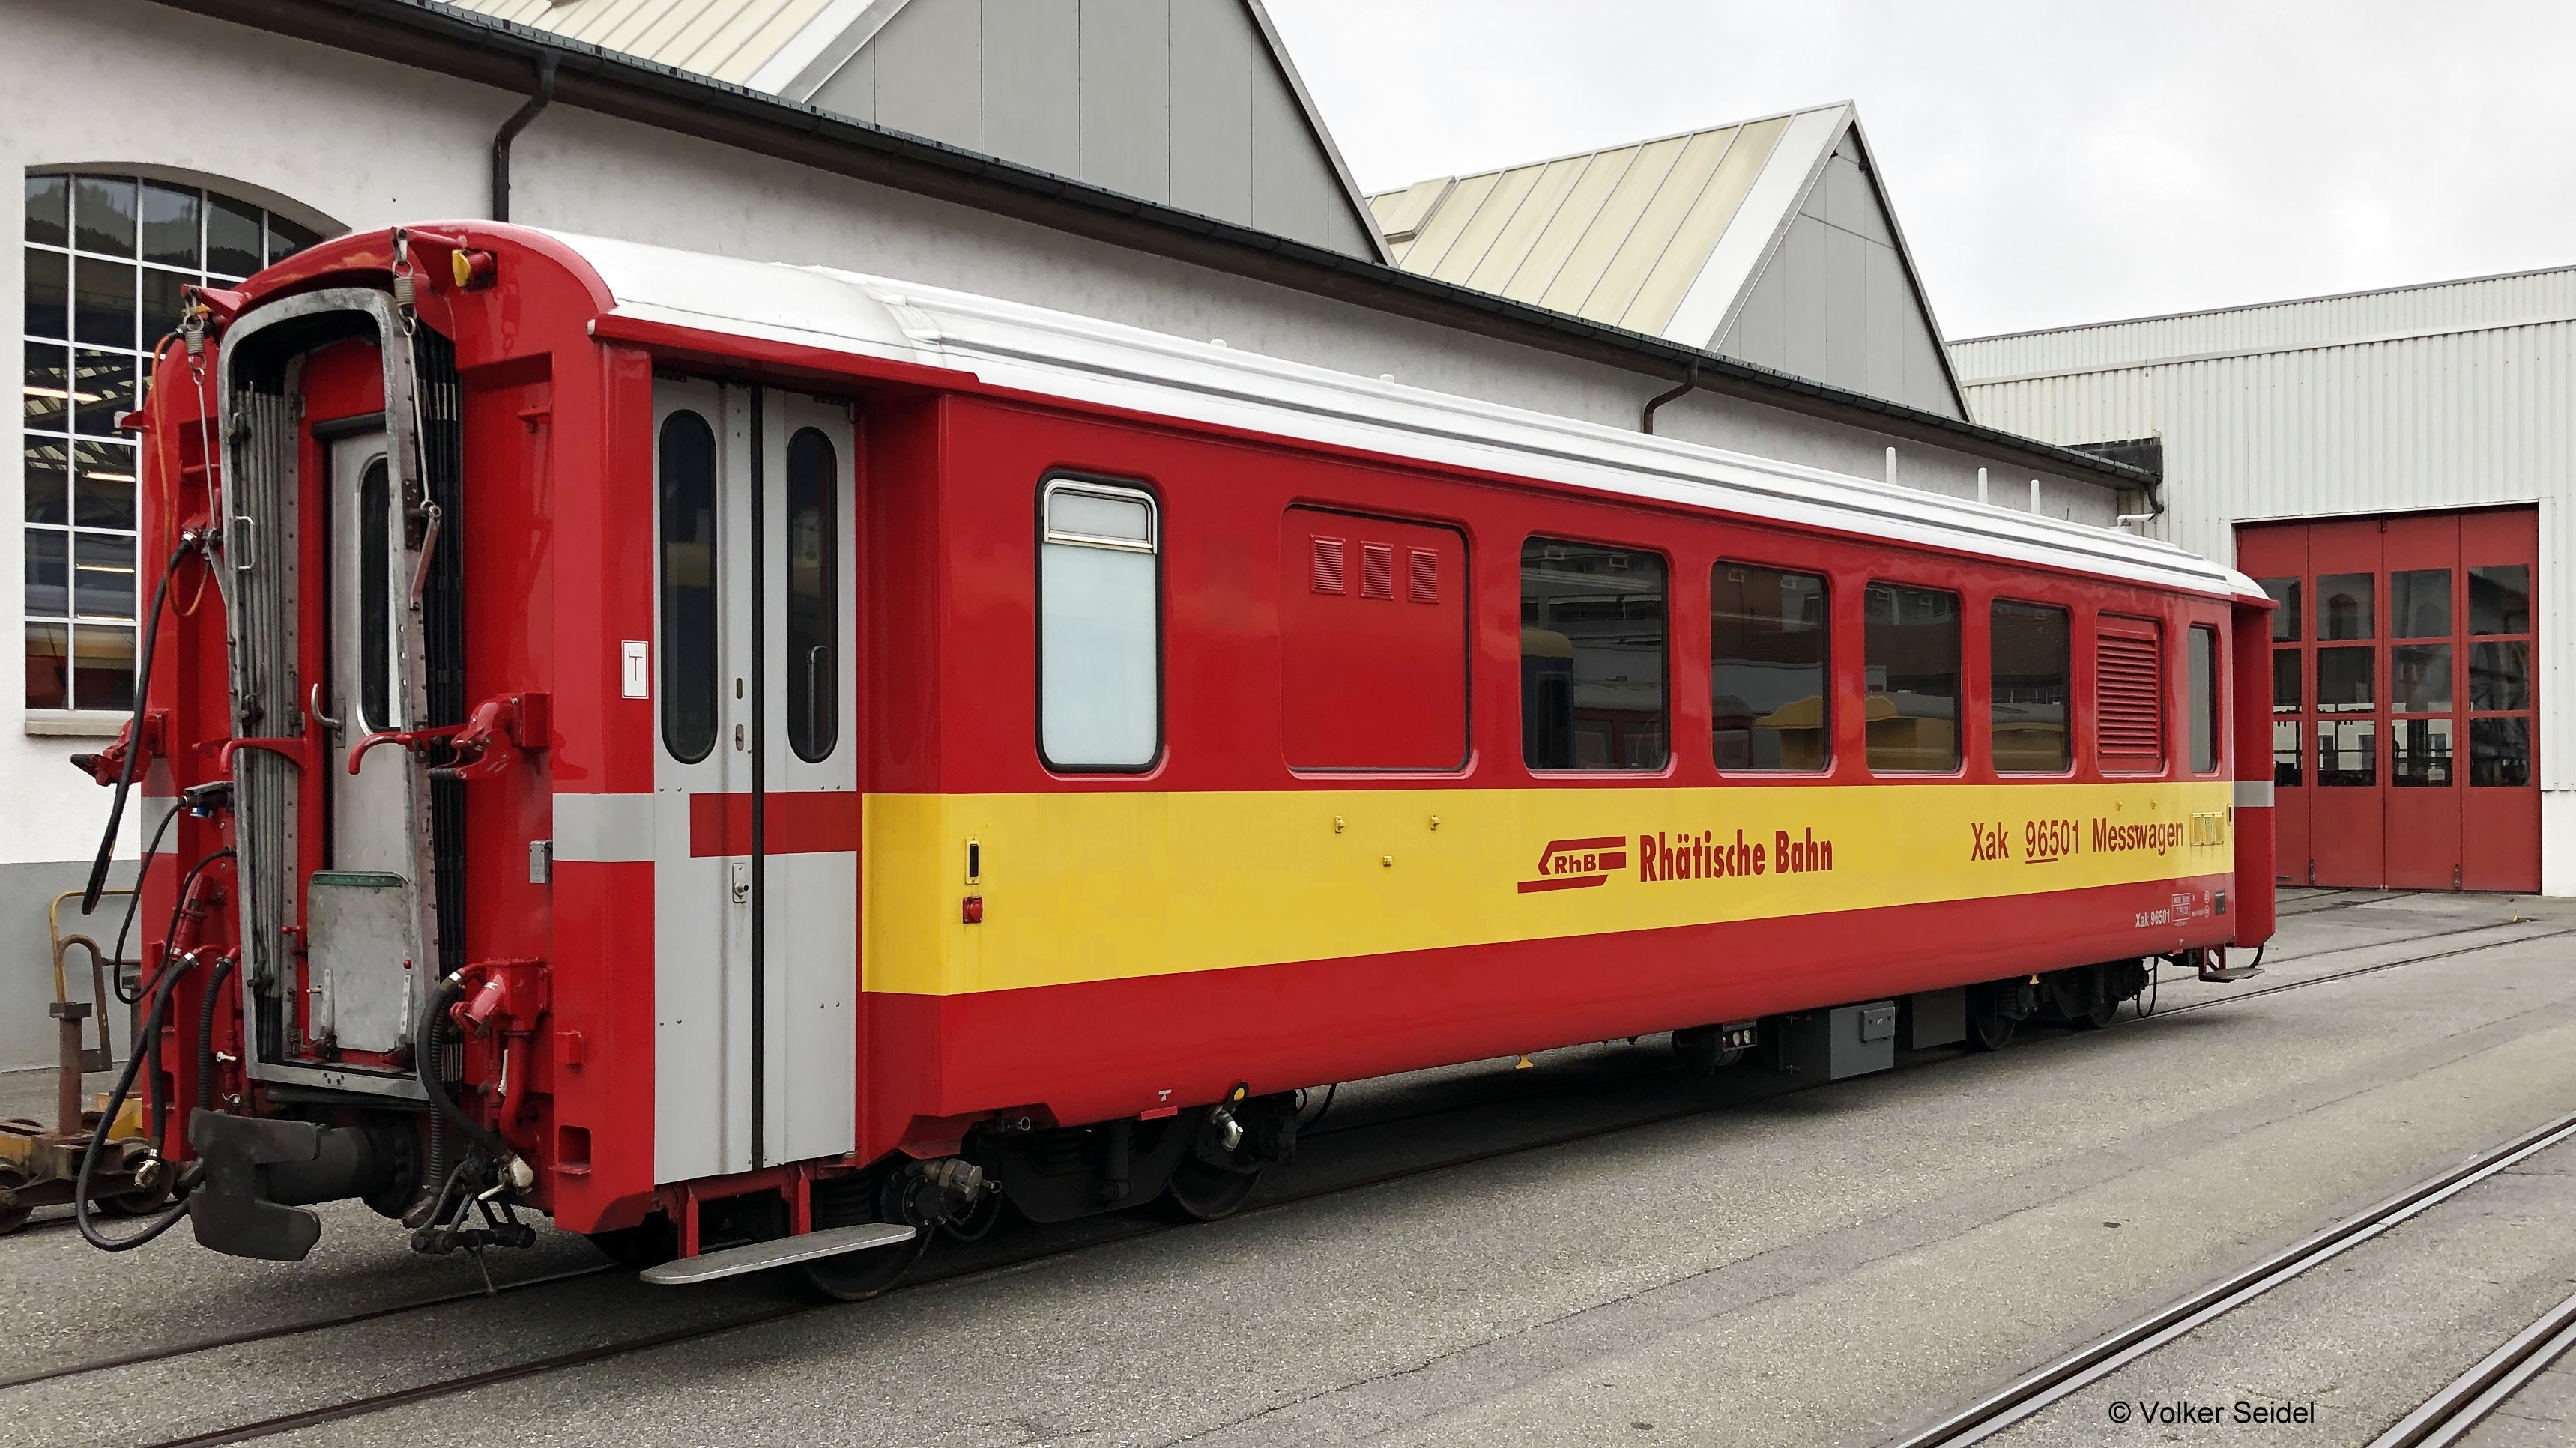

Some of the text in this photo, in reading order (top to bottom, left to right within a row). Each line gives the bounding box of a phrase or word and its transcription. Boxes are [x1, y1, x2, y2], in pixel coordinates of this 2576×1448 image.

[1639, 827, 1833, 882] Rhätische Bahn
[1971, 817, 2184, 861] Xak 96501 Messwagen
[1554, 853, 1597, 875] RhB
[2135, 912, 2150, 927] Xak
[2150, 909, 2170, 925] 96501
